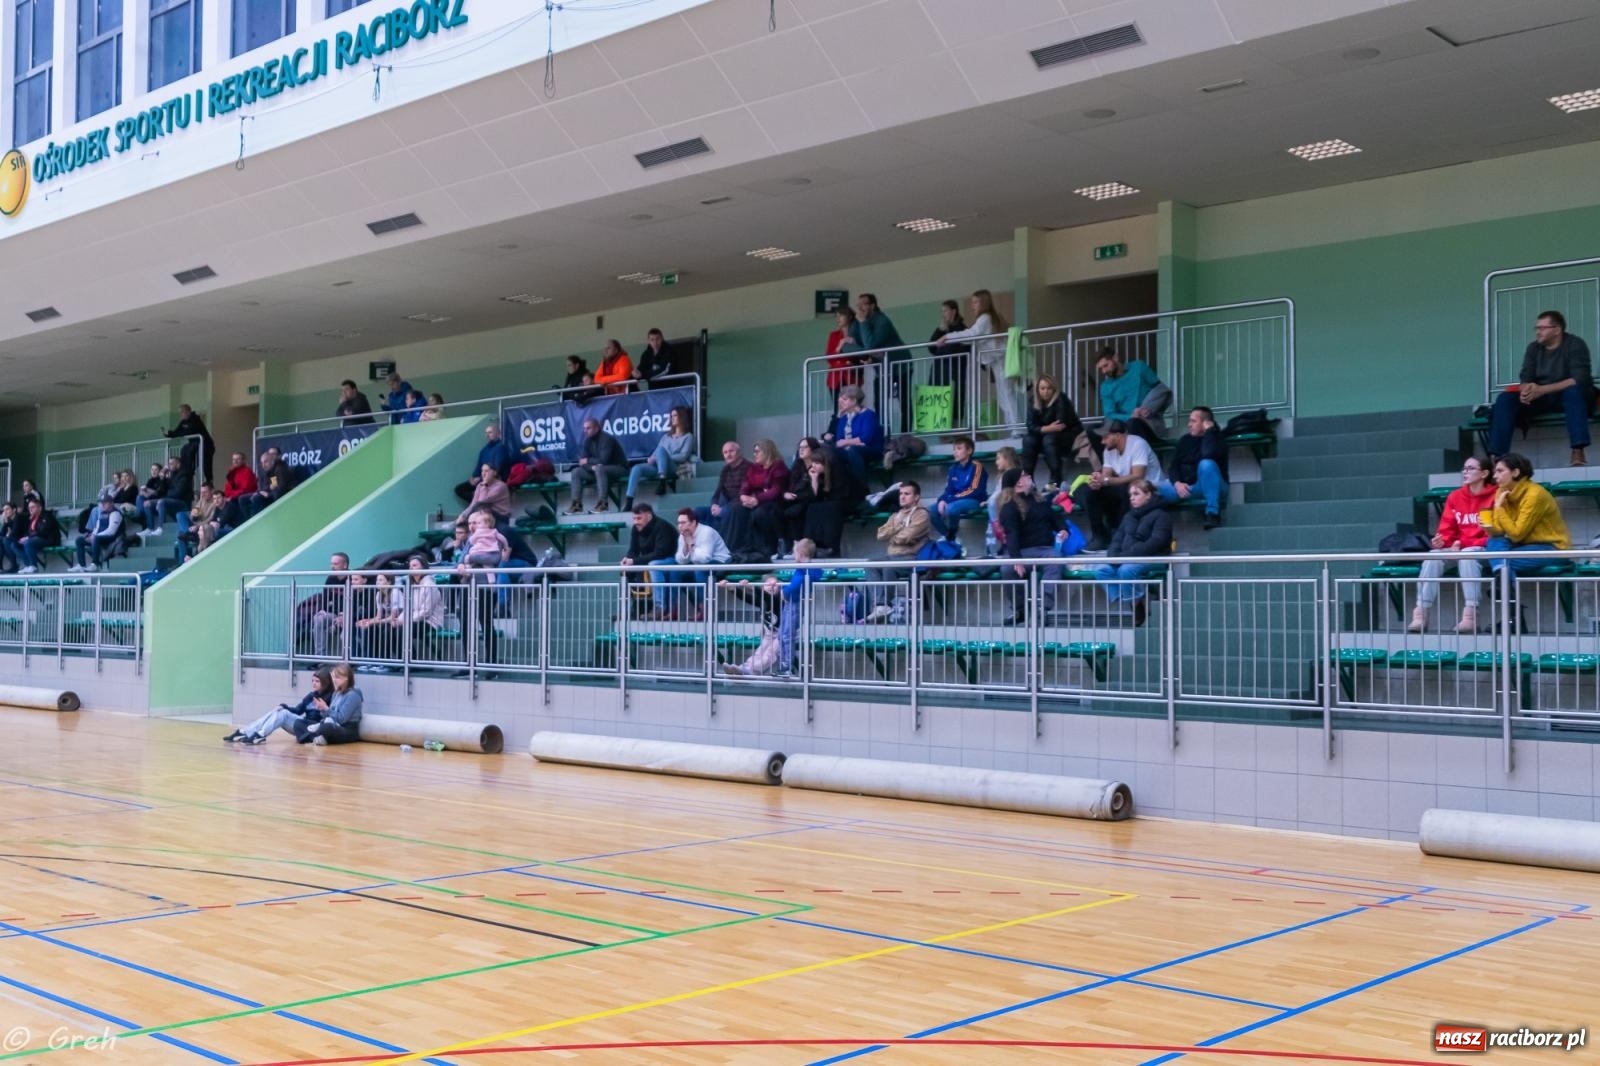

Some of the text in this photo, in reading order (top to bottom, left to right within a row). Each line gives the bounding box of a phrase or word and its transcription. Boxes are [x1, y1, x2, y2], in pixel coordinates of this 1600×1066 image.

[33, 126, 110, 183] OŚRODEK
[114, 93, 191, 153] SPORTU
[195, 89, 203, 123] I
[208, 39, 327, 118] REKREACJI
[824, 297, 840, 312] F
[603, 409, 672, 436] ACIBÓRZ
